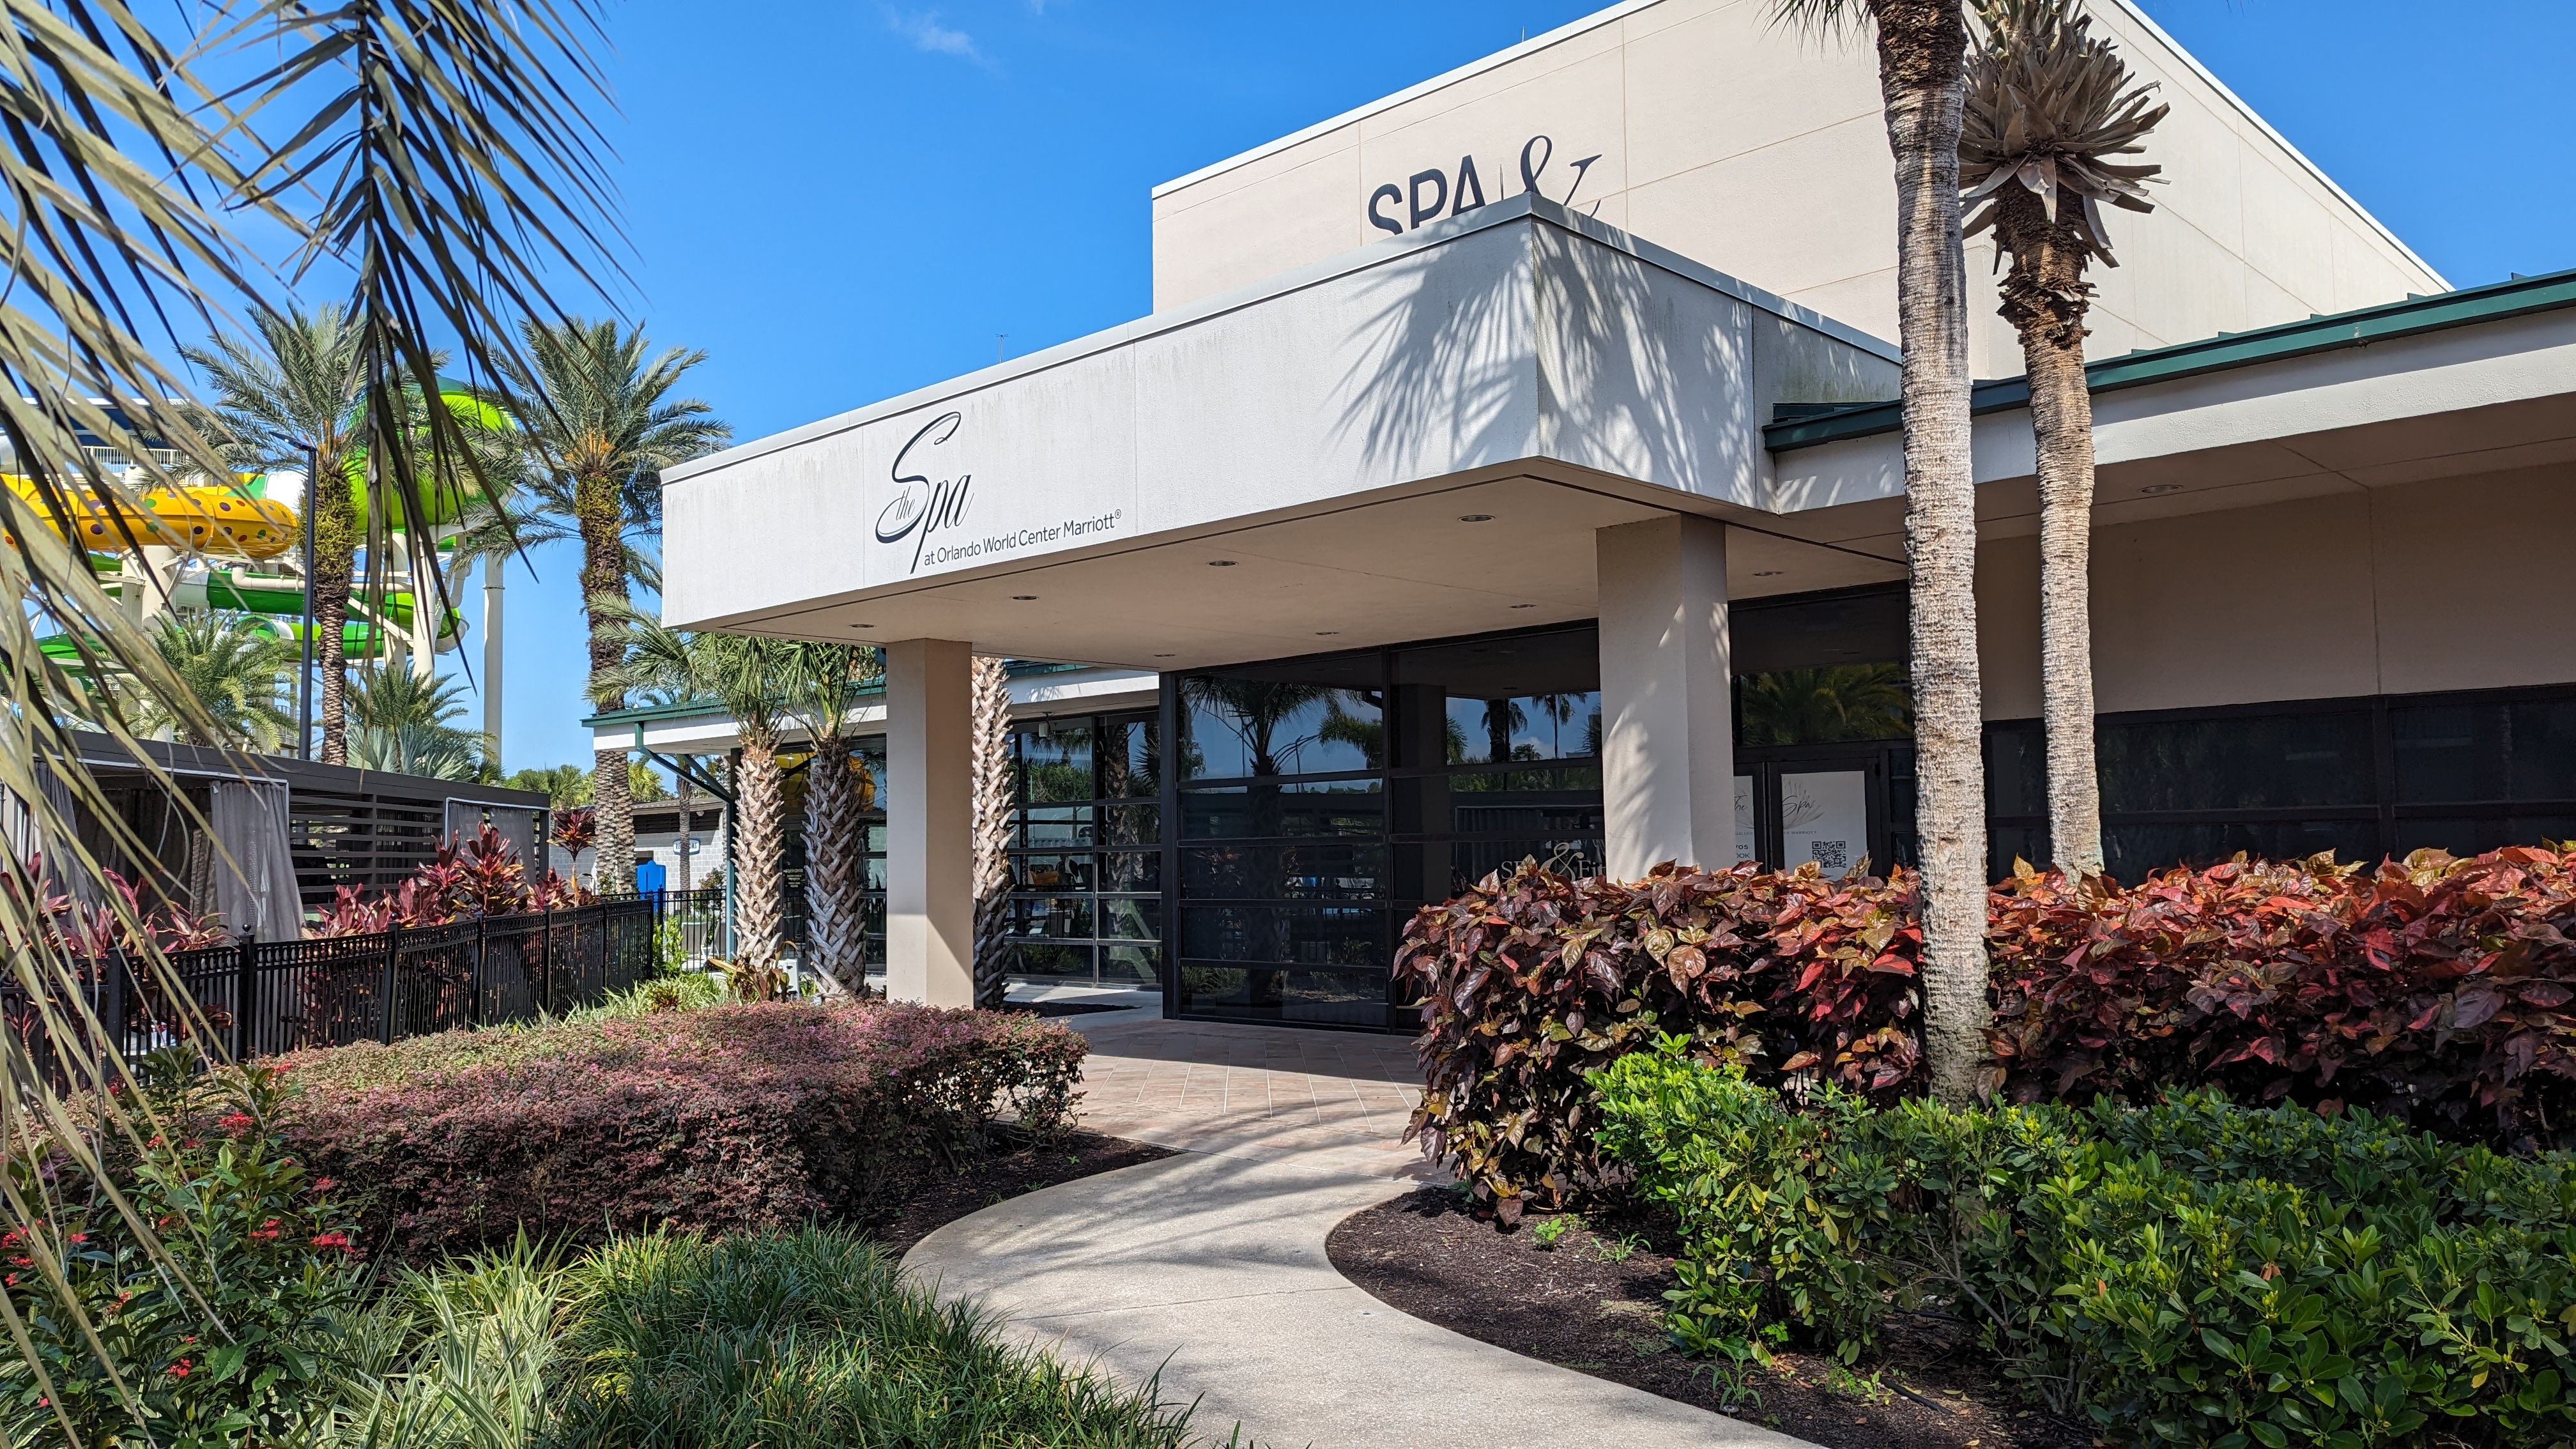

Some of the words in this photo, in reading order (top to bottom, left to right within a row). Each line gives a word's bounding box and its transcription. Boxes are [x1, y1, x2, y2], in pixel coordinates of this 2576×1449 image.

[1368, 154, 1486, 236] SPA
[1521, 135, 1603, 218] &
[875, 411, 975, 574] Spa
[896, 486, 916, 521] the
[924, 551, 935, 565] at
[937, 541, 981, 563] Orlando
[983, 532, 1016, 553] World
[1019, 526, 1061, 546] Center
[1538, 842, 1584, 883] &
